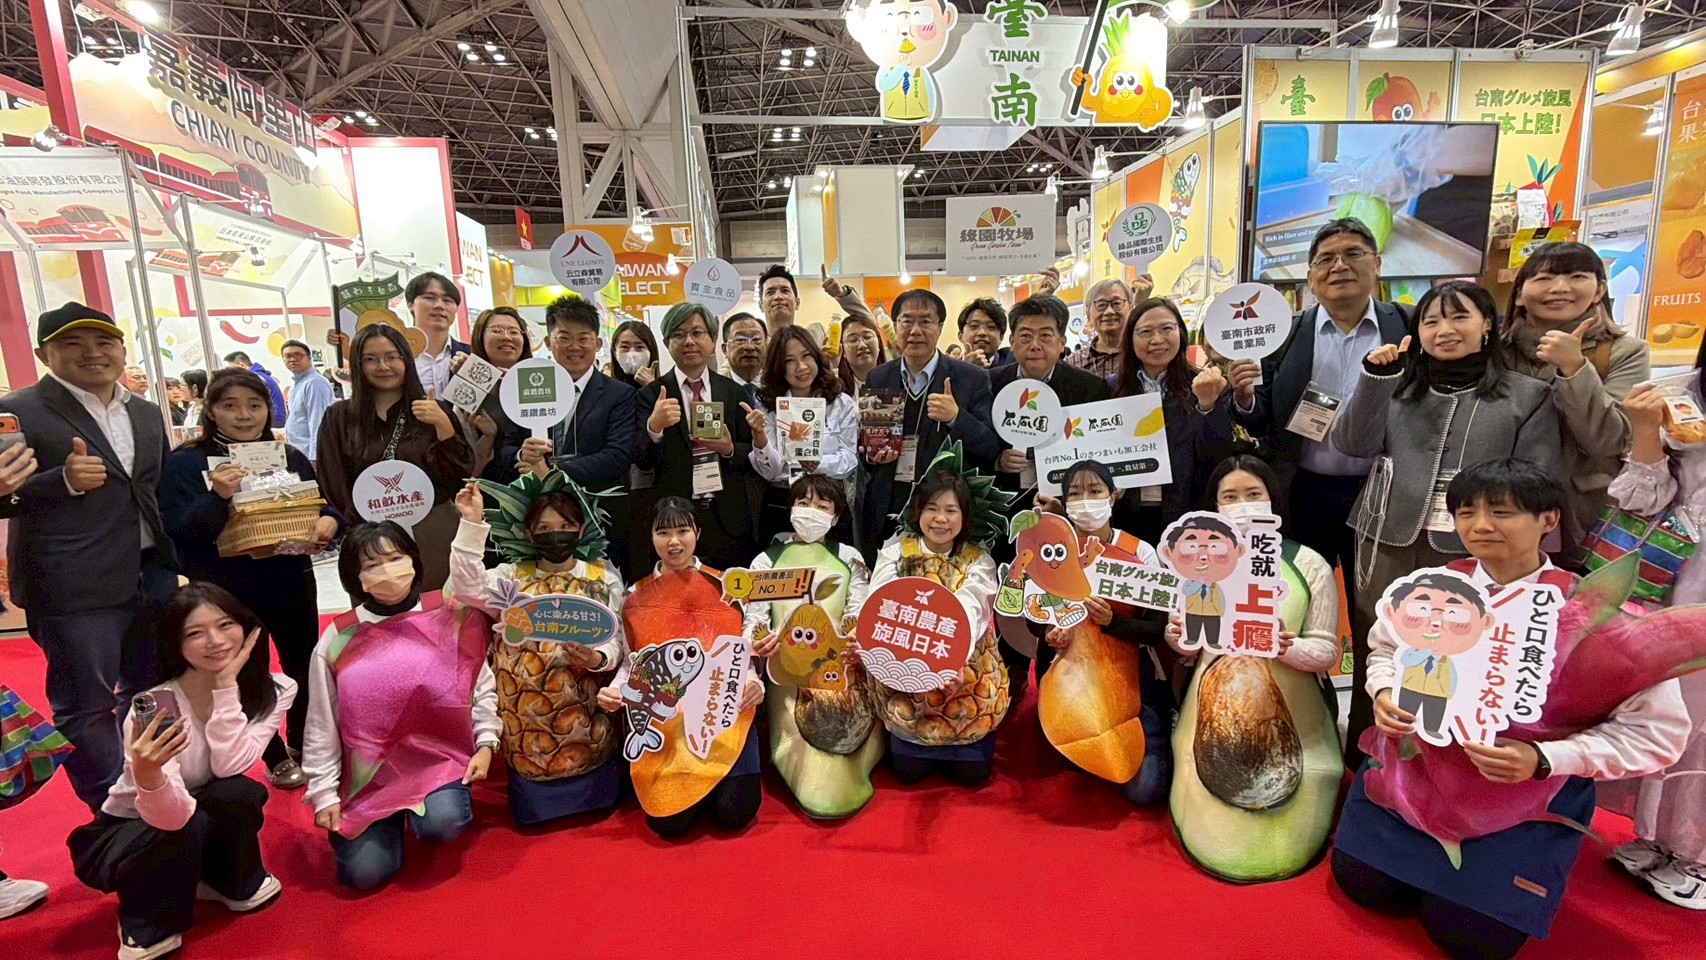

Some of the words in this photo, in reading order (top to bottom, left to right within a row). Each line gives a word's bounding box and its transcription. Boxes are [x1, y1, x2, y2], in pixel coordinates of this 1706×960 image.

[990, 49, 1040, 62] TAINAN
[140, 32, 317, 157] 嘉義阿里山
[991, 72, 1038, 126] 南
[1280, 74, 1316, 116] 臺
[1474, 88, 1572, 108] 台南グルメ旋風
[171, 100, 239, 154] CHIAYI
[243, 135, 311, 184] COUNTY
[1118, 244, 1164, 259] 股份有限公司
[615, 263, 672, 277] AIWAN
[571, 277, 601, 287] 有限公司
[620, 281, 671, 295] ELECT
[1653, 292, 1702, 307] FRUITS
[1220, 323, 1277, 341] 臺南市政府
[1233, 337, 1267, 351] 農業局
[384, 509, 414, 520] HOMOO
[733, 577, 742, 590] 1
[758, 584, 776, 595] NO.
[1233, 519, 1277, 653] 一吃就上癮
[1098, 578, 1179, 610] 日本上陸!
[534, 610, 601, 622] 心に染みる甘さ!
[877, 598, 958, 639] 臺南農產
[535, 621, 602, 639] 台南フルーツ
[871, 621, 952, 660] 旋風日本
[1513, 589, 1556, 717] ひと口食べたら
[720, 643, 746, 729] ひと口食べたら
[1475, 622, 1517, 746] 止まらない!
[700, 666, 725, 754] 止まらない!
